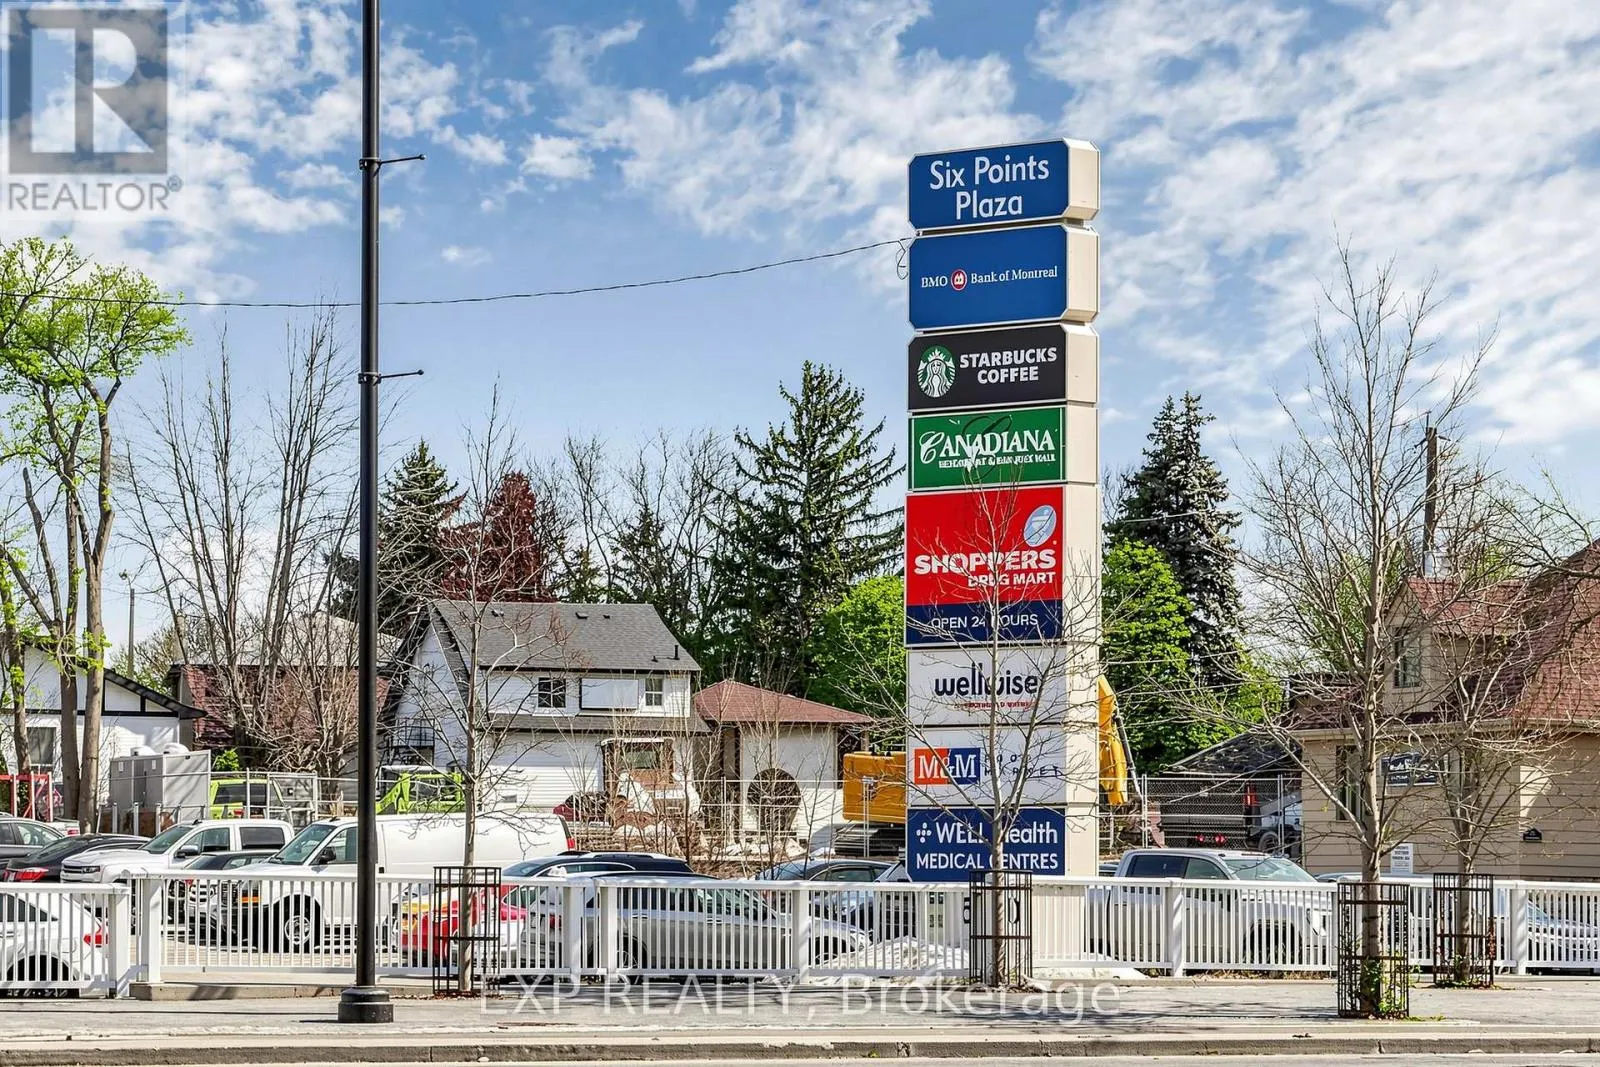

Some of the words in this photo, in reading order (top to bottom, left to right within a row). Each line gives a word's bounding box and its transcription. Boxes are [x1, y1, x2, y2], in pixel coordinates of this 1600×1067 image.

[929, 160, 966, 190] Six
[974, 154, 1050, 185] Points
[956, 190, 1023, 220] Plaza
[921, 275, 948, 288] BMO
[971, 271, 998, 284] Bank
[999, 270, 1010, 282] of
[1011, 265, 1058, 281] Montreal
[959, 347, 1058, 369] STARBUCKS
[977, 366, 1039, 385] COFFEE
[919, 429, 1056, 464] CANADIANA
[914, 549, 1057, 575] SHOPPERS
[1013, 571, 1056, 585] MART
[931, 616, 968, 629] OPEN
[971, 616, 986, 628] 24
[991, 613, 1039, 627] OURS
[918, 754, 977, 779] M&M
[984, 766, 1059, 776] MRET
[935, 822, 988, 844] WELL
[916, 853, 985, 869] MEDICAL
